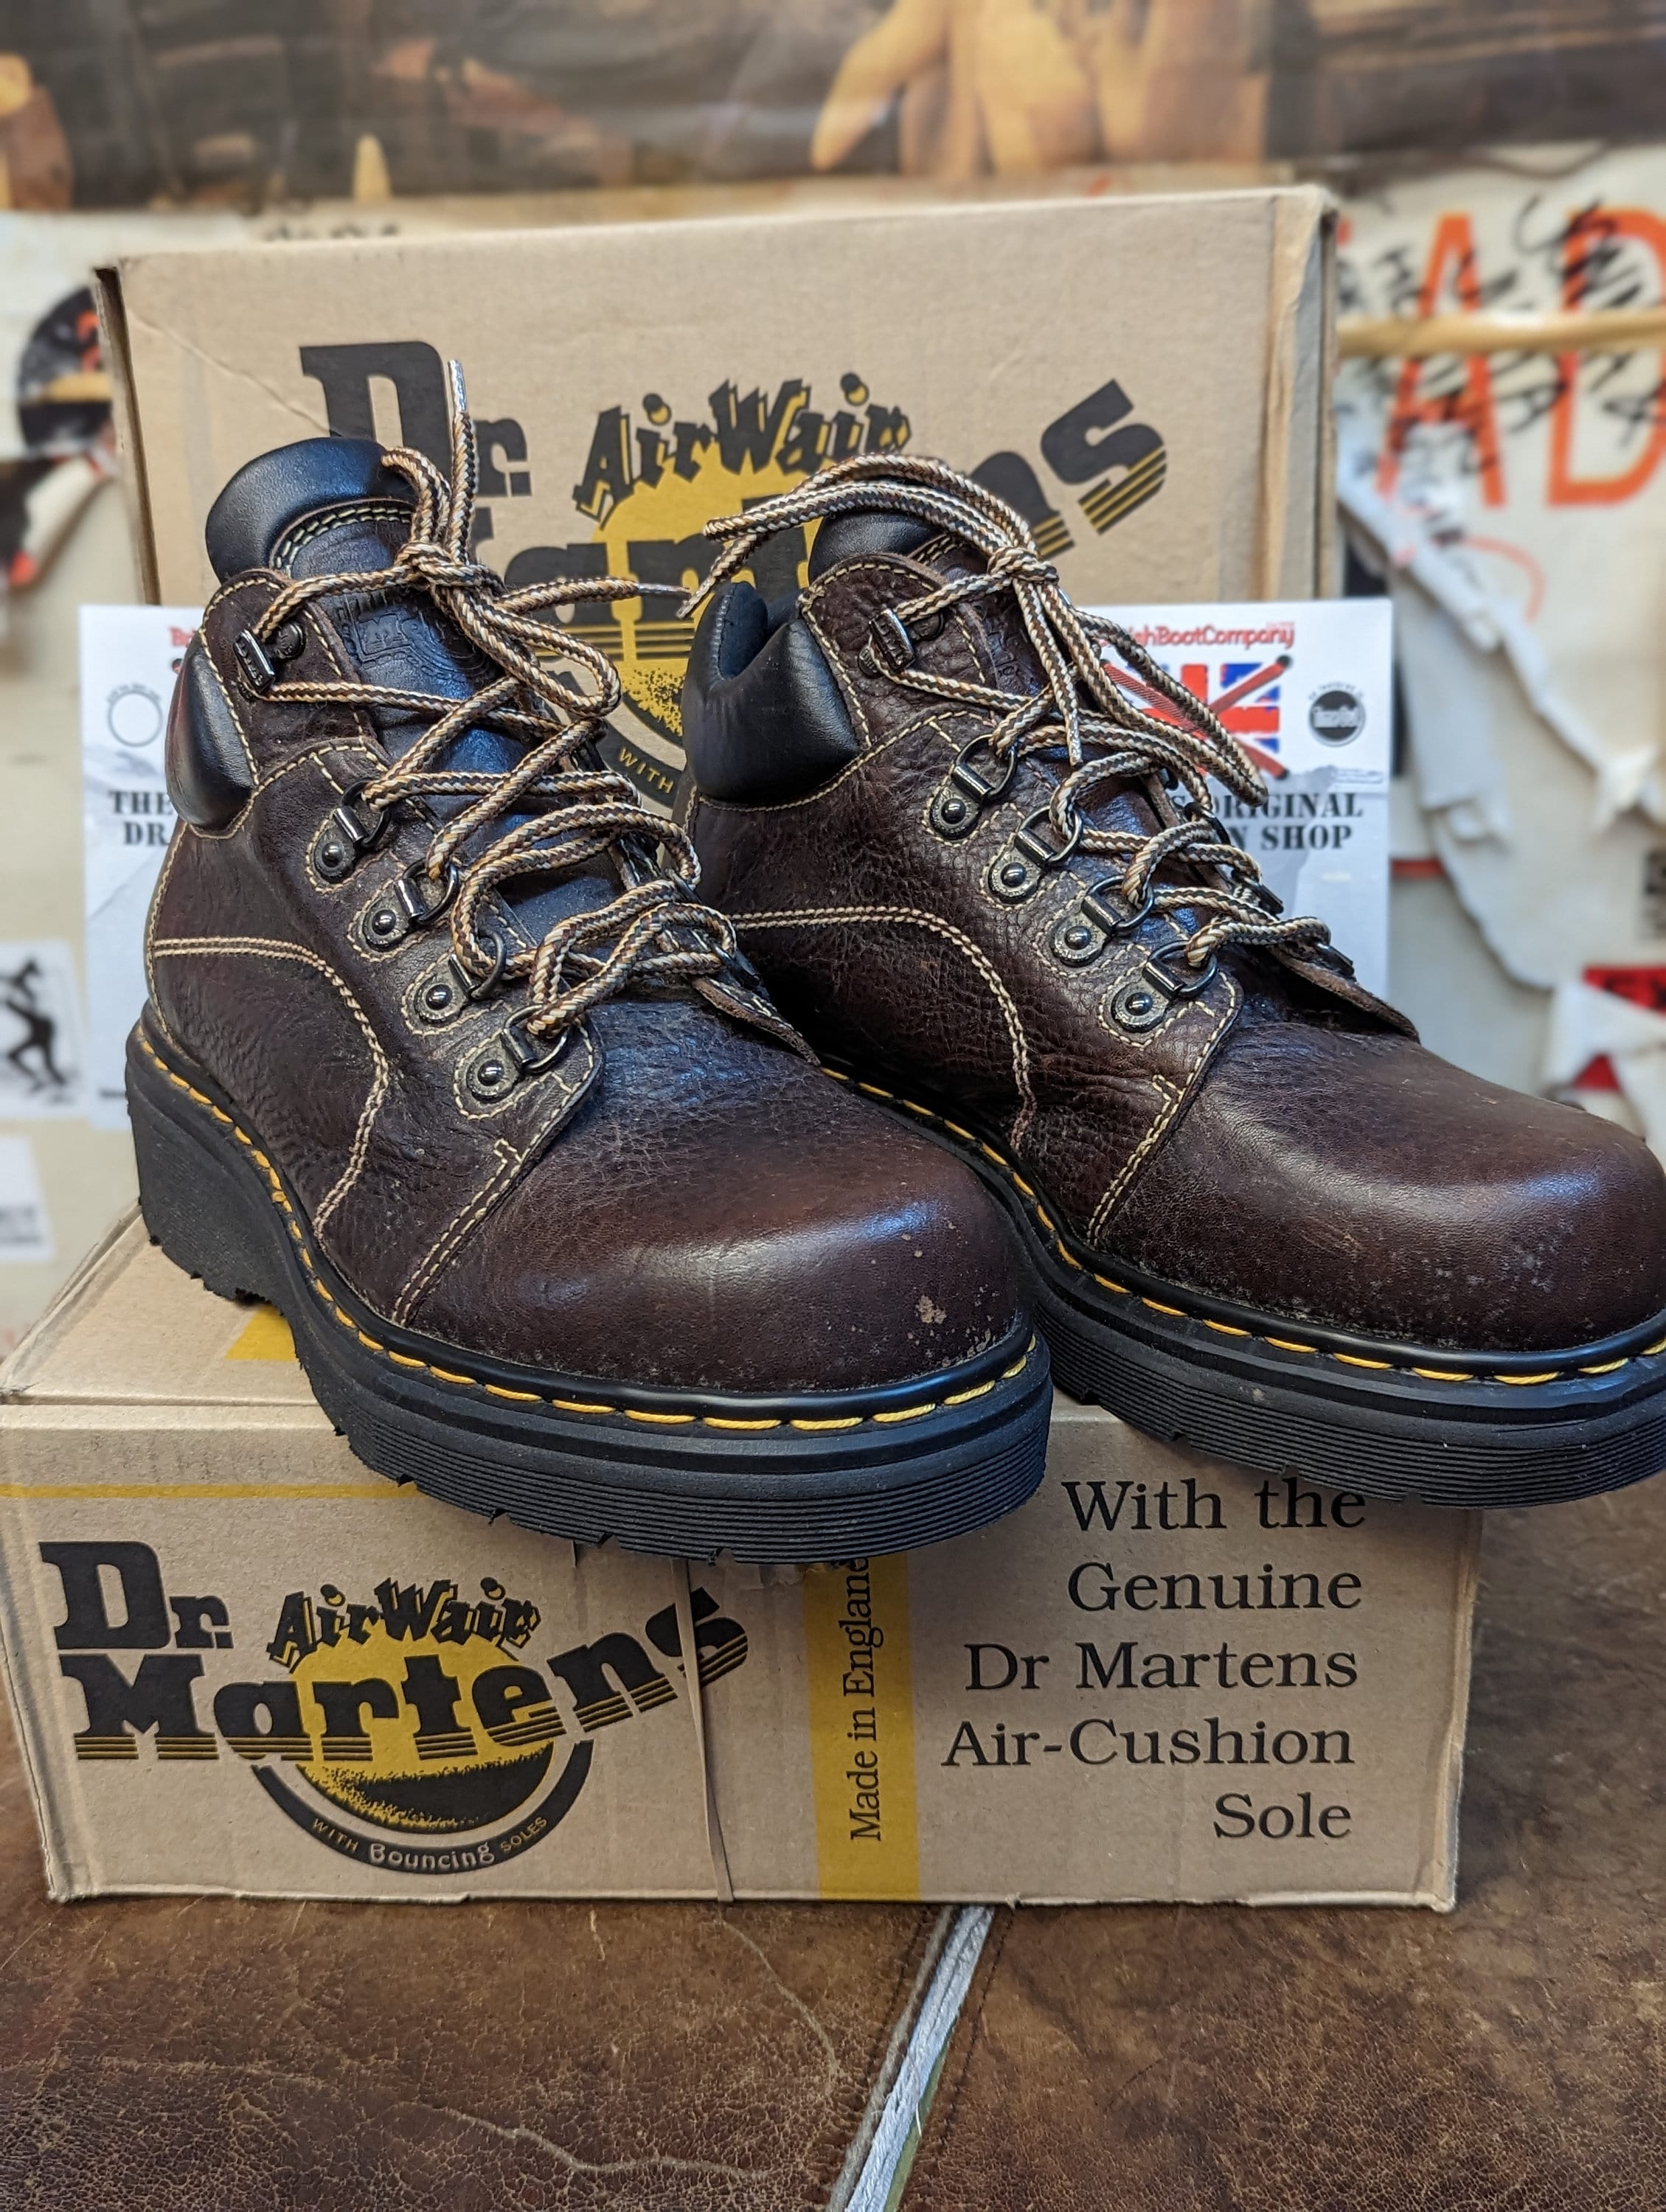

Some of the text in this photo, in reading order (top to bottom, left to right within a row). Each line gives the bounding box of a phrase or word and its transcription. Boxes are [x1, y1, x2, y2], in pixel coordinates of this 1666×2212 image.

[572, 372, 912, 522] AirWair
[619, 747, 674, 794] WITH
[109, 790, 174, 815] THE
[1262, 826, 1352, 850] SHOP
[1061, 1477, 1366, 1531] With the
[39, 1540, 234, 1649] Dr.
[1068, 1562, 1361, 1612] Genuine
[266, 1576, 541, 1673] AirWair
[59, 1587, 748, 1761] Martens
[964, 1642, 1358, 1691] Dr Martens
[847, 1707, 877, 1742] in
[941, 1717, 1355, 1767] Air-Cushion
[847, 1750, 881, 1842] Made
[1213, 1792, 1352, 1838] Sole
[313, 1817, 549, 1871] WITH Bouncing SOLES
